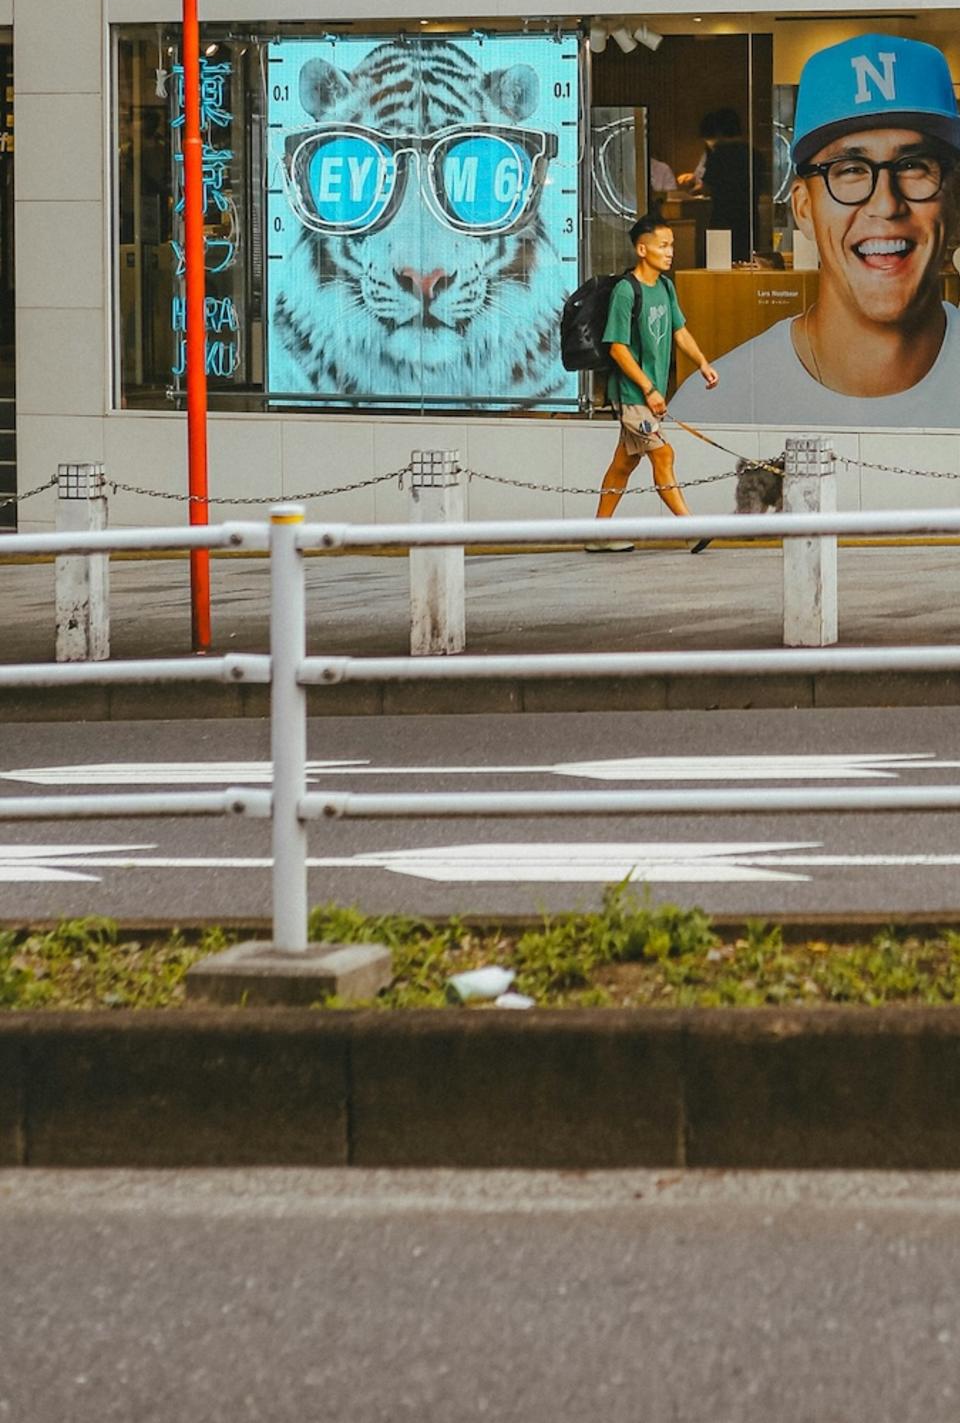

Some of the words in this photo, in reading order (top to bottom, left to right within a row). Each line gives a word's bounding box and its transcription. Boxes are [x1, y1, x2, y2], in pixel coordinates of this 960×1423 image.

[273, 84, 290, 102] 0.1
[554, 82, 571, 99] 0.1
[851, 52, 896, 104] N
[171, 296, 238, 333] HRA
[171, 339, 236, 376] JKU
